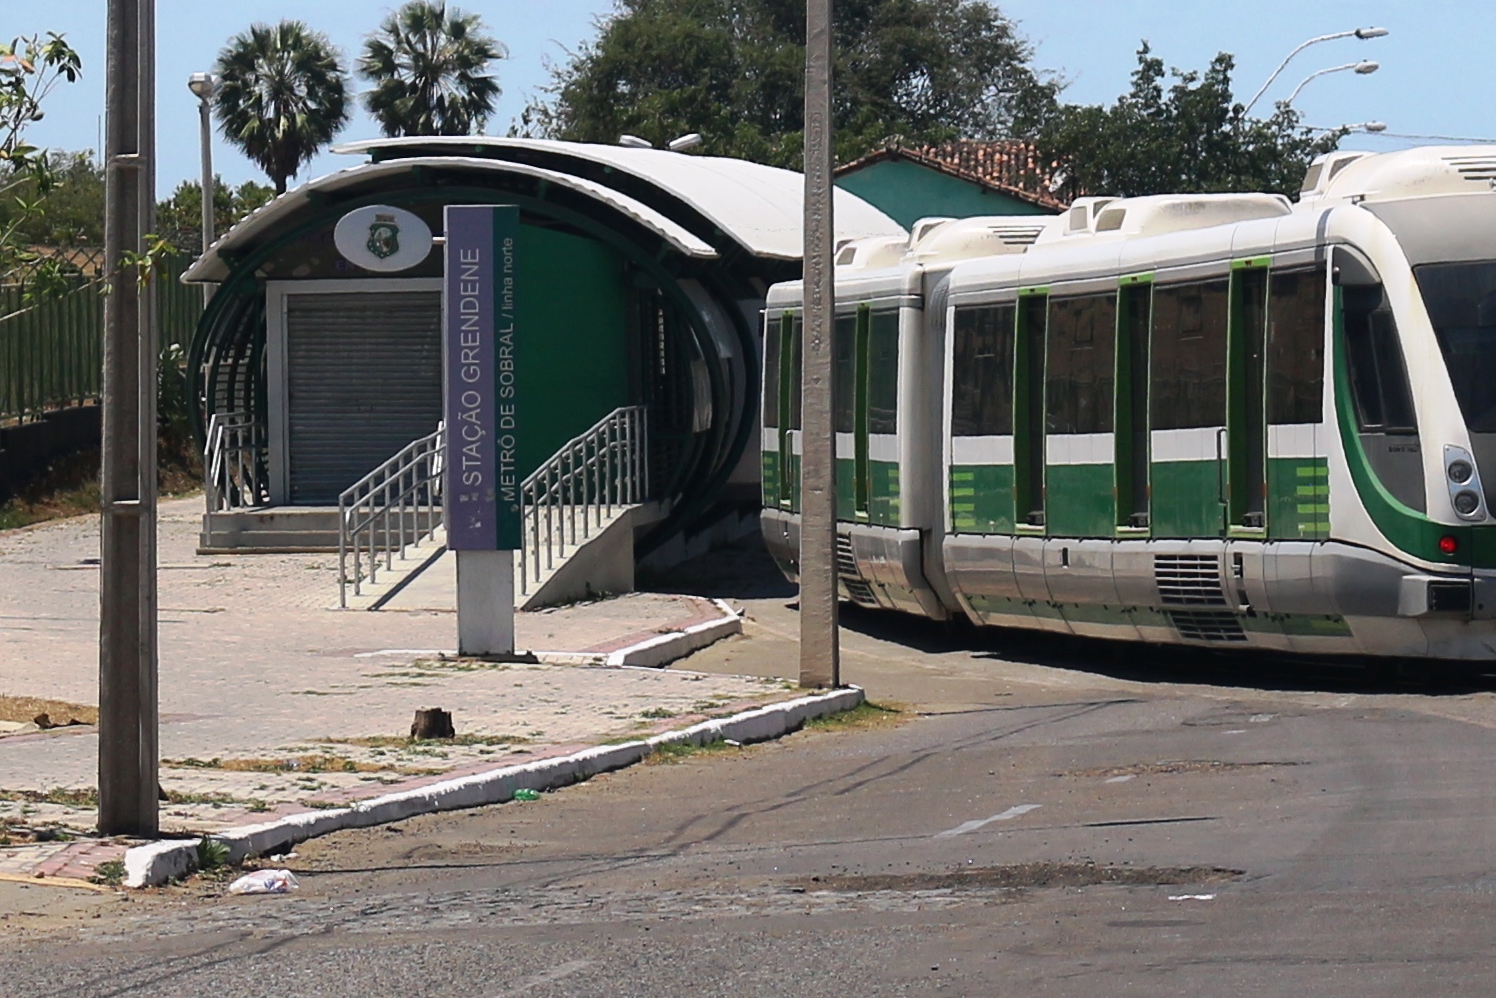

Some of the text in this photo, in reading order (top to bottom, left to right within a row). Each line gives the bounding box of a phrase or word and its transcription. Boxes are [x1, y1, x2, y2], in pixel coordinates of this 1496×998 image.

[501, 237, 513, 273] norte
[502, 277, 513, 310] linha
[458, 248, 486, 486] STAÇÃO GRENDENE
[499, 323, 515, 398] SOBRAL
[500, 404, 515, 429] DE
[497, 434, 516, 501] METRÔ
